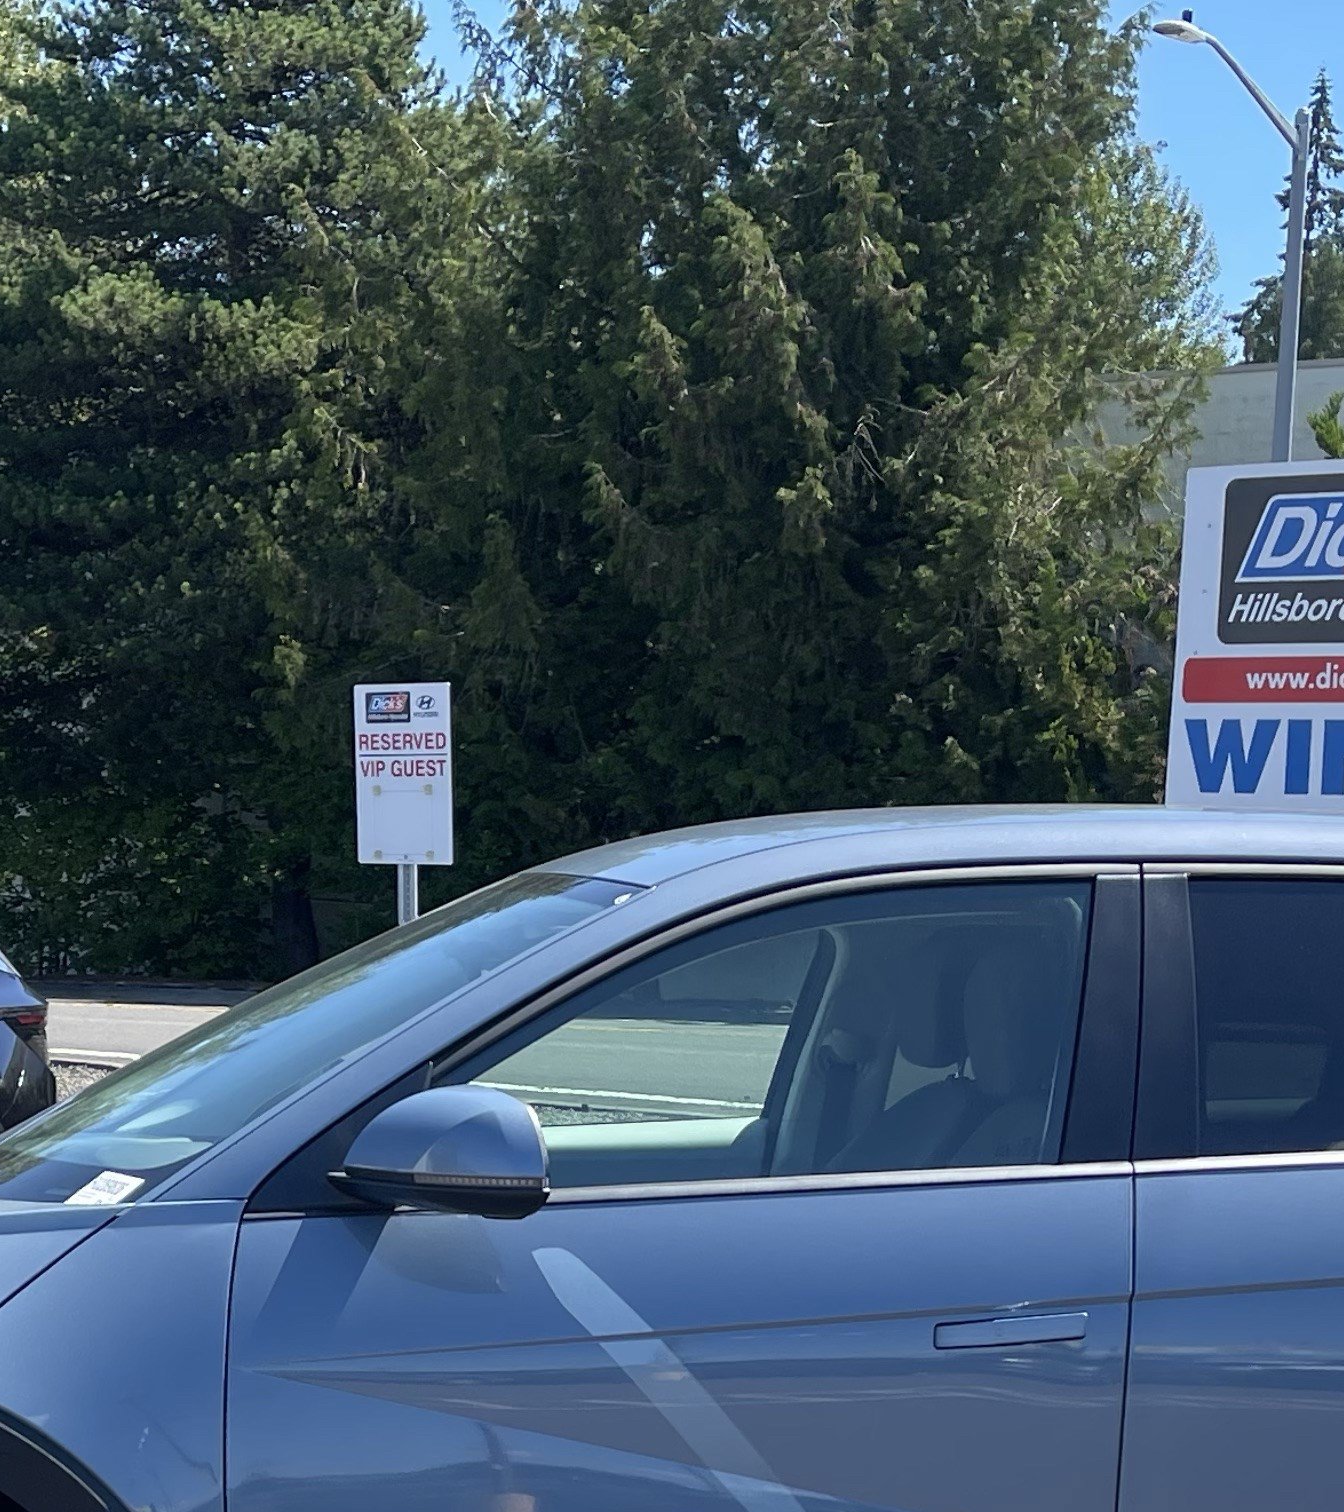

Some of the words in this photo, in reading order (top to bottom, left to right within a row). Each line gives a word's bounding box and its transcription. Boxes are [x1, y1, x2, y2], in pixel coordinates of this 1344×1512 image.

[358, 732, 446, 751] RESERVED
[360, 760, 386, 777] VIP
[391, 759, 447, 777] GUEST
